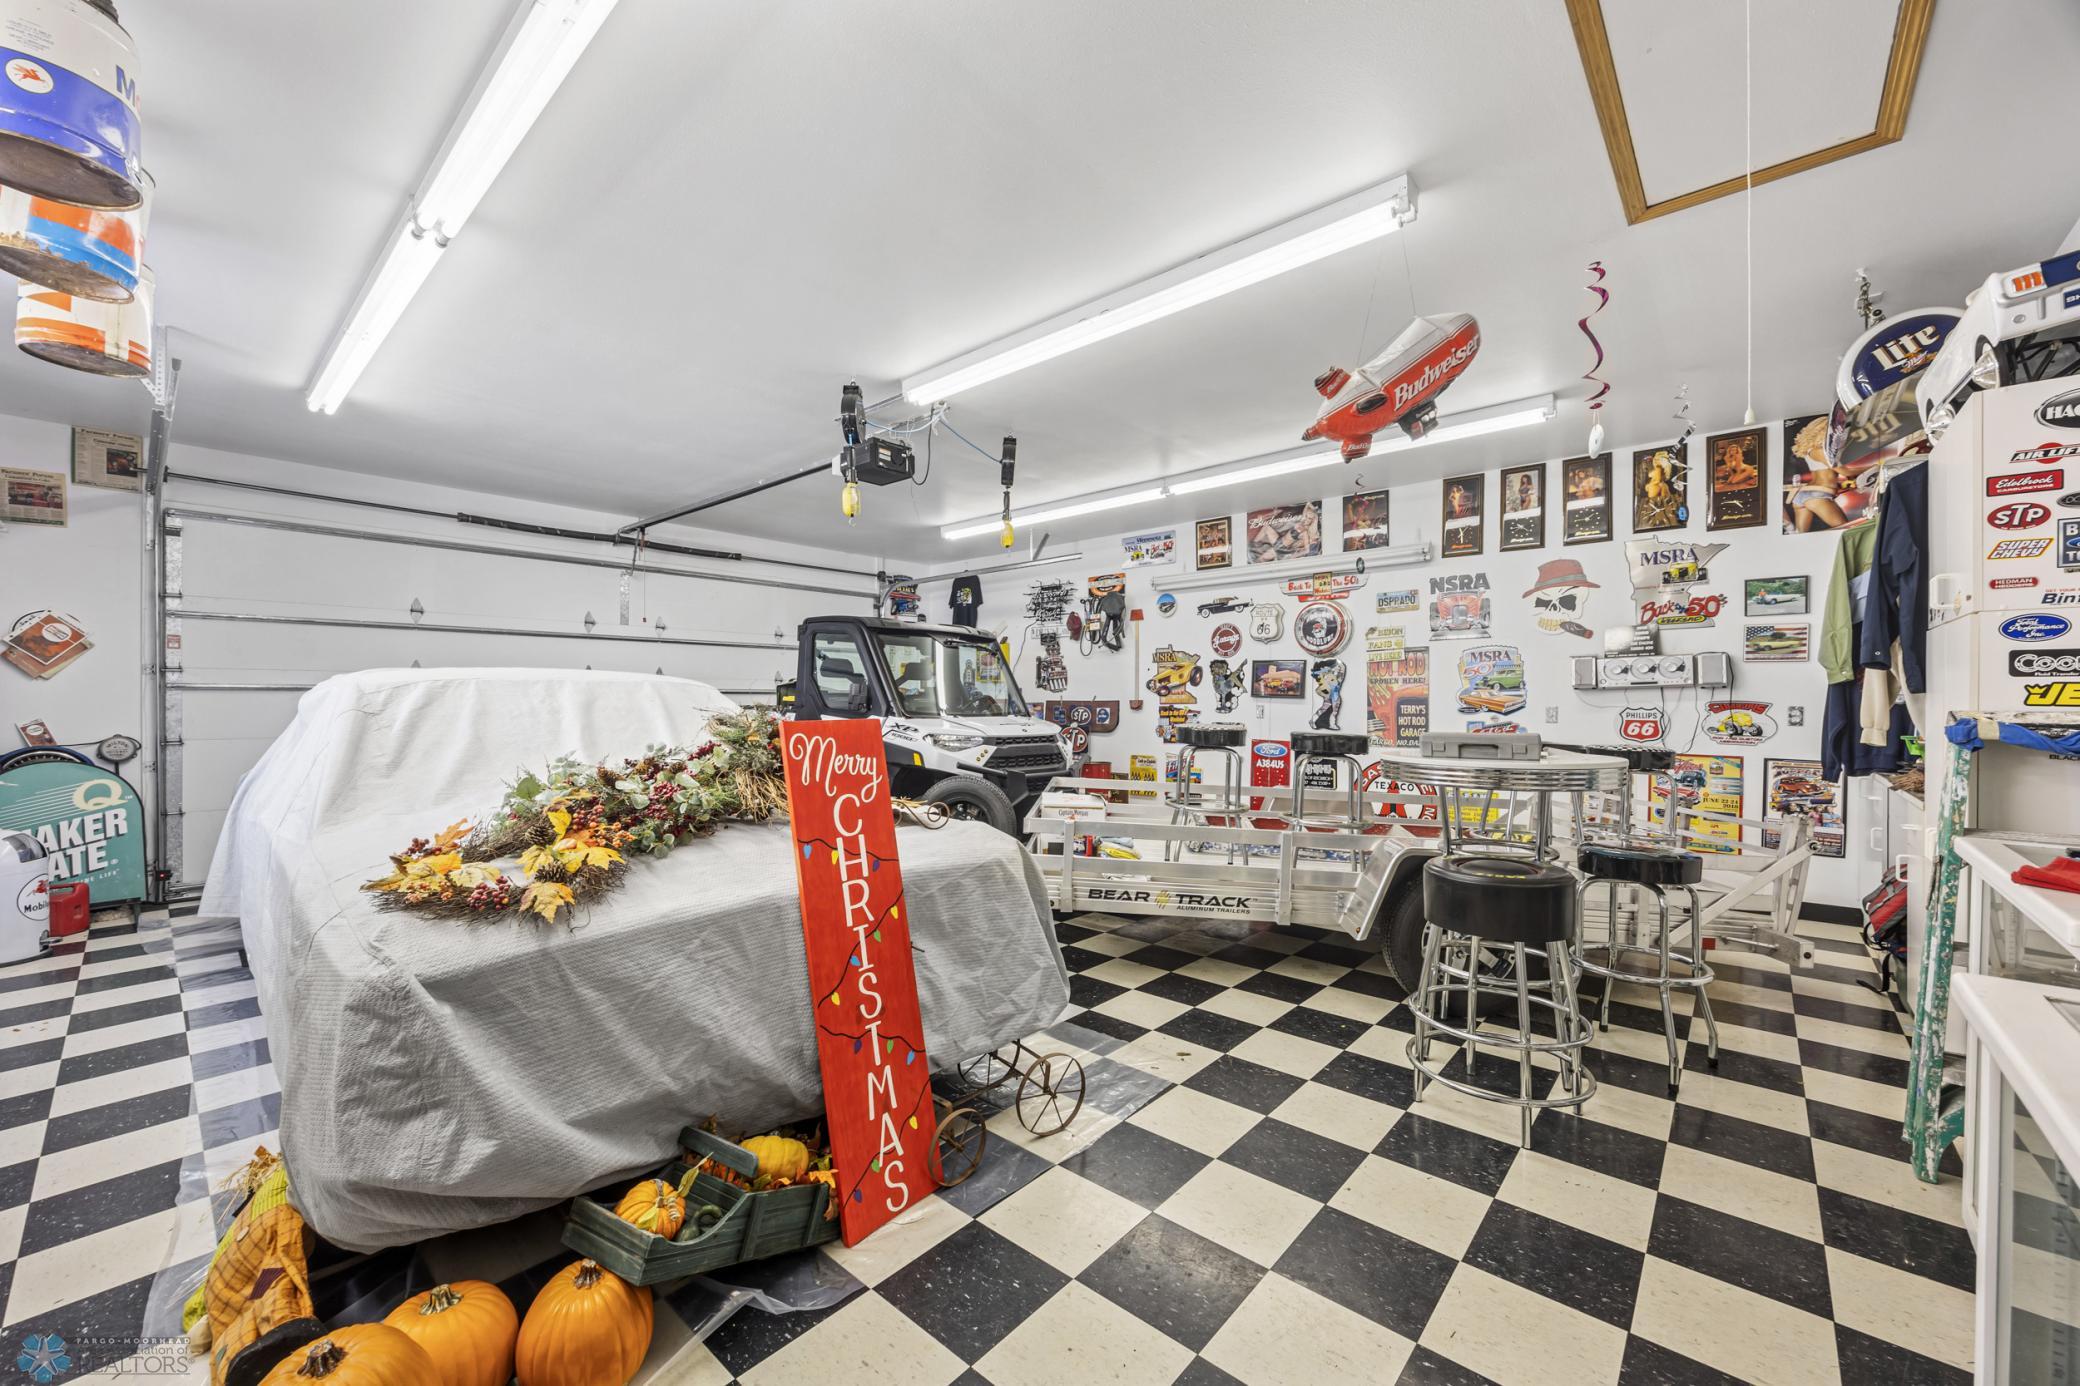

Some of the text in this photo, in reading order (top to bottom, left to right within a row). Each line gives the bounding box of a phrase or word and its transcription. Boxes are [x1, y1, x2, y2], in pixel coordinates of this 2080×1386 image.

[1871, 325, 1940, 371] Lite
[1393, 334, 1481, 413] Budweiser
[2014, 451, 2045, 460] AIR
[1996, 475, 2054, 489] Edelbrock
[1994, 504, 2045, 526] STP
[1998, 539, 2050, 550] SUPER
[1640, 547, 1700, 566] MSRA
[1990, 547, 2044, 559] CHEVY
[1429, 572, 1491, 595] NSRA
[1995, 577, 2033, 585] HEDMAN
[1641, 600, 1675, 625] Back
[1256, 622, 1271, 635] 66
[2007, 623, 2066, 633] Performance
[1368, 640, 1393, 649] FANS
[1152, 651, 1177, 663] MSRA
[1470, 650, 1513, 662] MSRA
[1369, 652, 1426, 677] HOT ROD
[1369, 677, 1399, 685] SPOKEN
[1073, 709, 1089, 721] STP
[1400, 704, 1426, 714] TERRY'S
[1625, 711, 1658, 719] PHILLIPS
[890, 722, 919, 732] XP
[1398, 716, 1426, 726] HOT ROD
[1400, 727, 1426, 737] GARAGE
[1627, 722, 1656, 736] 66
[1259, 744, 1282, 757] Ford
[789, 733, 882, 803] Merry
[1256, 759, 1285, 769] A384US
[1374, 780, 1415, 792] TEXACO
[1088, 888, 1251, 909] BEAR TRACK
[833, 793, 909, 1213] CHRISTMAS
